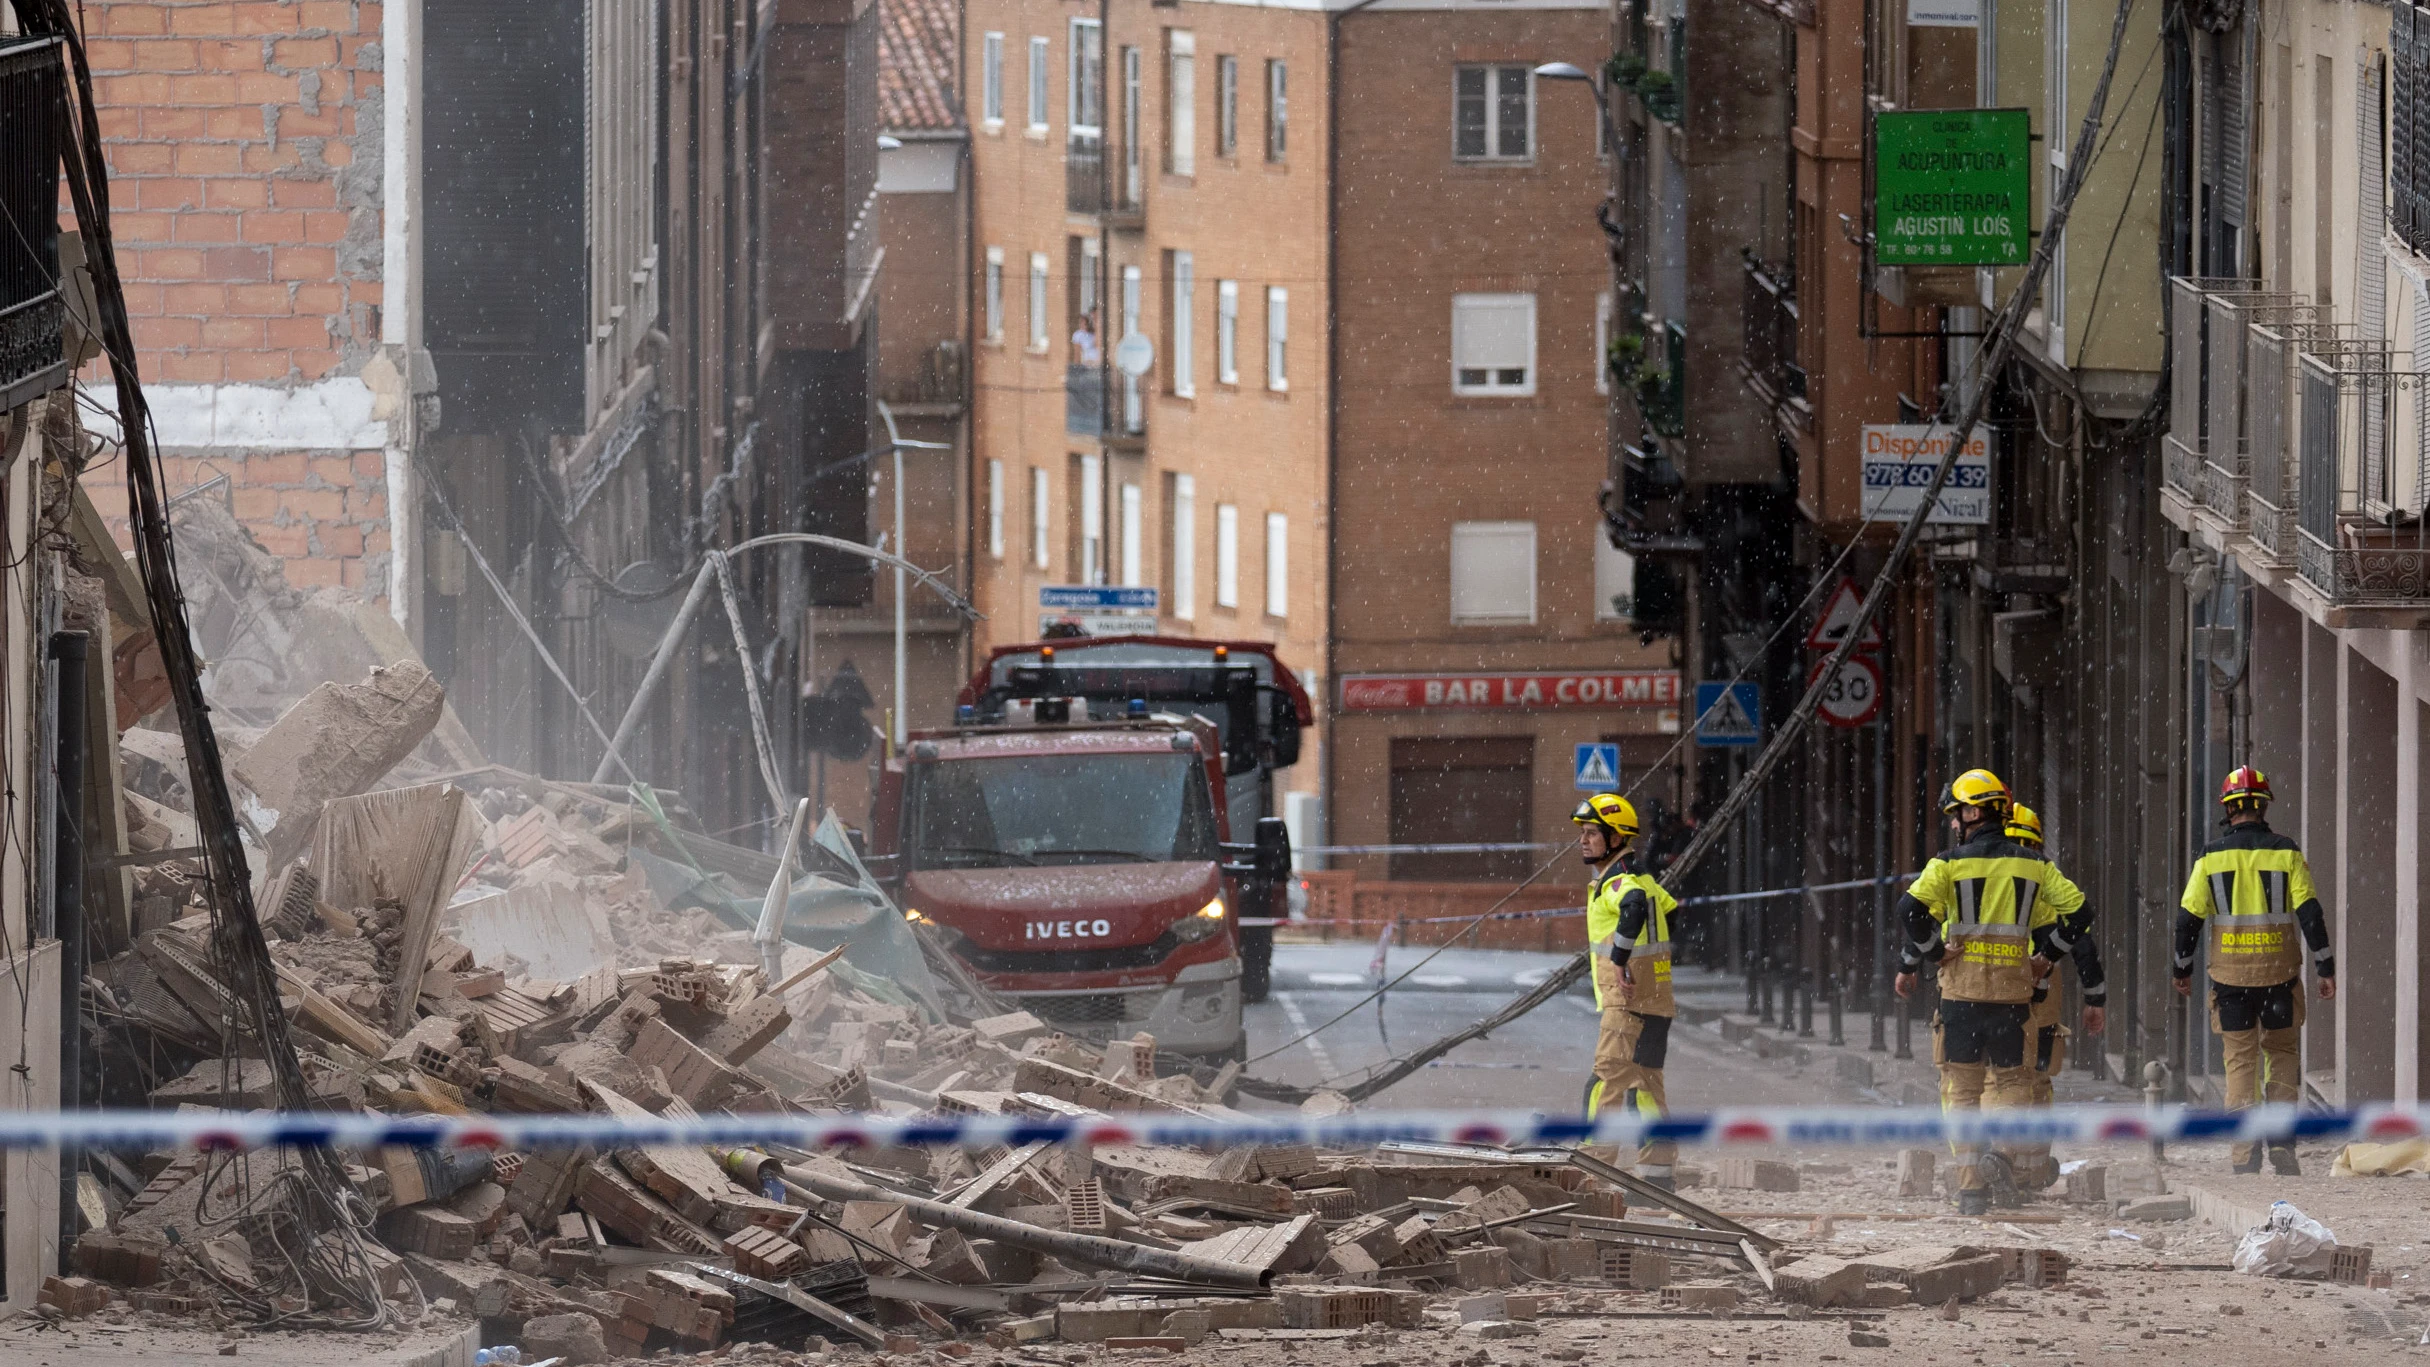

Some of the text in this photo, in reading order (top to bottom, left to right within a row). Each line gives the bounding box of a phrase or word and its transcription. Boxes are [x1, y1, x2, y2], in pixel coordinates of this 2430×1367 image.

[1898, 152, 2006, 171] ACUPUNTURA
[1892, 194, 2011, 212] LASERTERAPIA
[1894, 217, 2010, 236] AGUSTIN LOIS
[1867, 431, 1984, 460] Disponile
[1866, 465, 1904, 486] 978
[1907, 466, 1933, 486] 60
[1960, 467, 1985, 487] 39
[1424, 681, 1490, 705] BAR
[1502, 679, 1543, 704] LA
[1827, 677, 1868, 702] 30
[1026, 919, 1111, 940] IVECO
[2221, 932, 2284, 946] BOMBEROS
[1964, 941, 2023, 958] BOMBEROS
